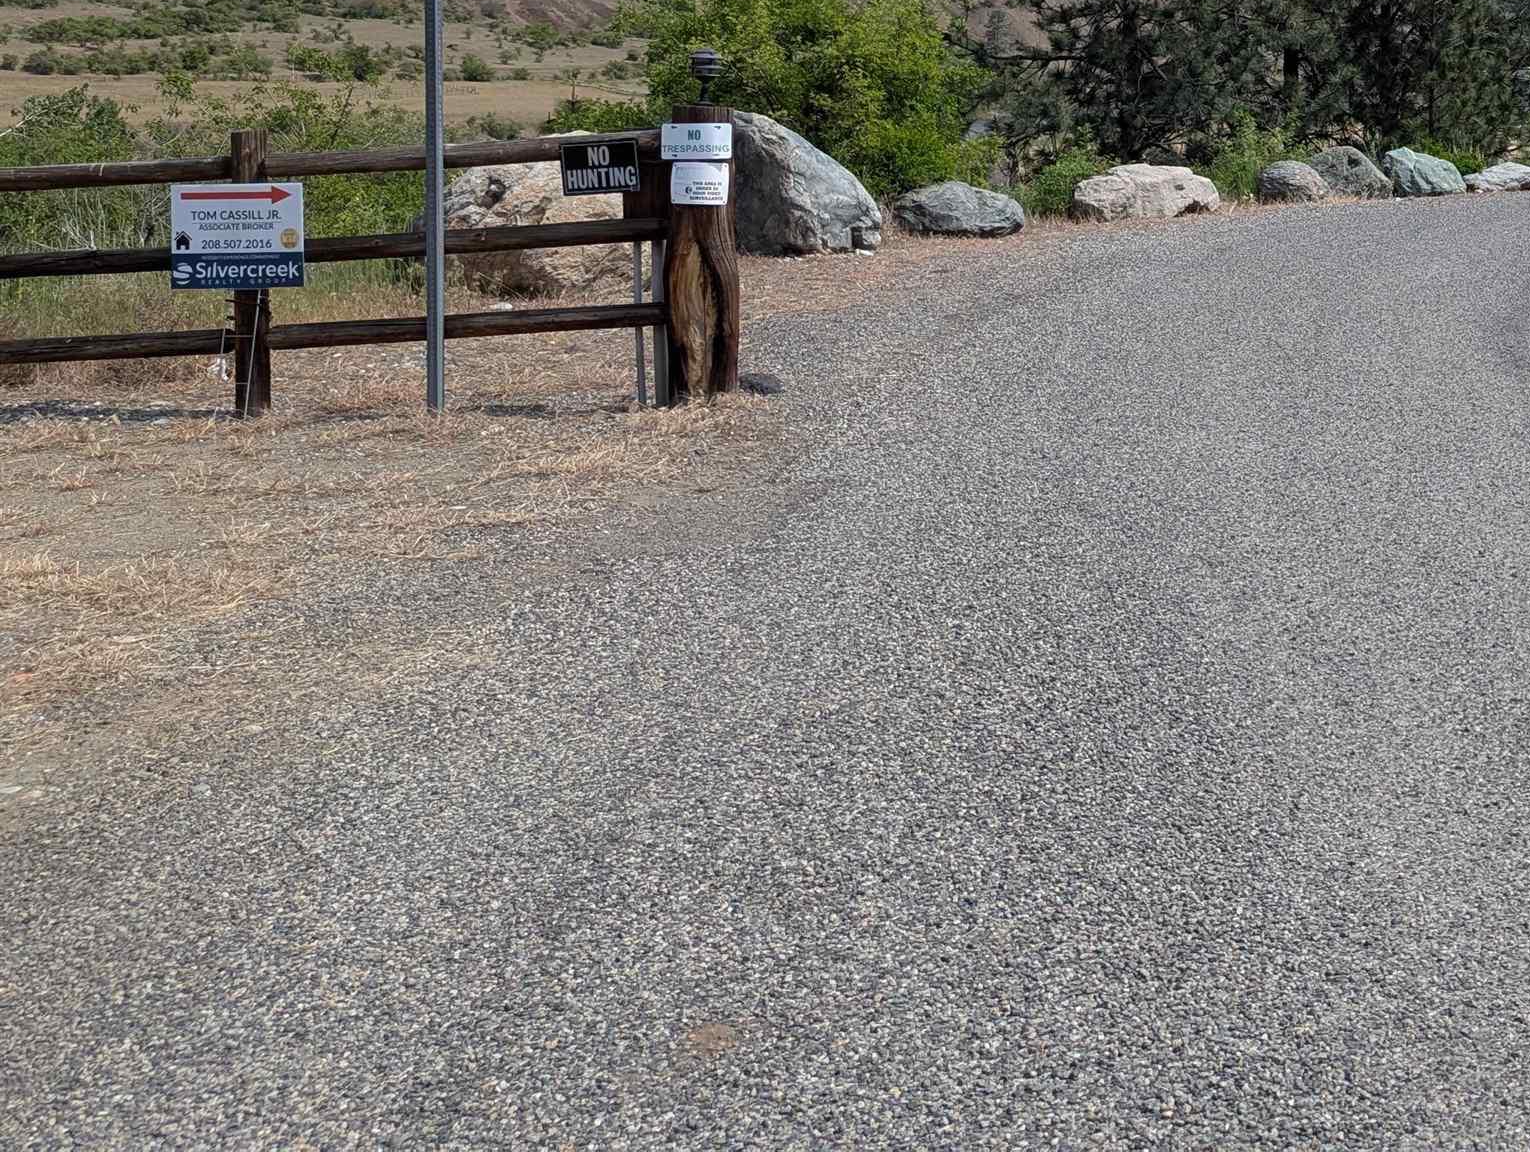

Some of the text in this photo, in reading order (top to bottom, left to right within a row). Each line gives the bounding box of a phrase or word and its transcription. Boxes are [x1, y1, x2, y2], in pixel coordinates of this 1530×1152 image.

[687, 129, 701, 141] NO
[662, 144, 730, 153] TRESPASSING
[587, 146, 610, 167] NO
[567, 165, 637, 190] HUNTING
[191, 209, 282, 221] TOM CASSILL JR.
[199, 223, 274, 231] ASSOCIATE BROKER
[201, 239, 272, 249] 208.507.2016
[195, 261, 299, 279] Silvercreek
